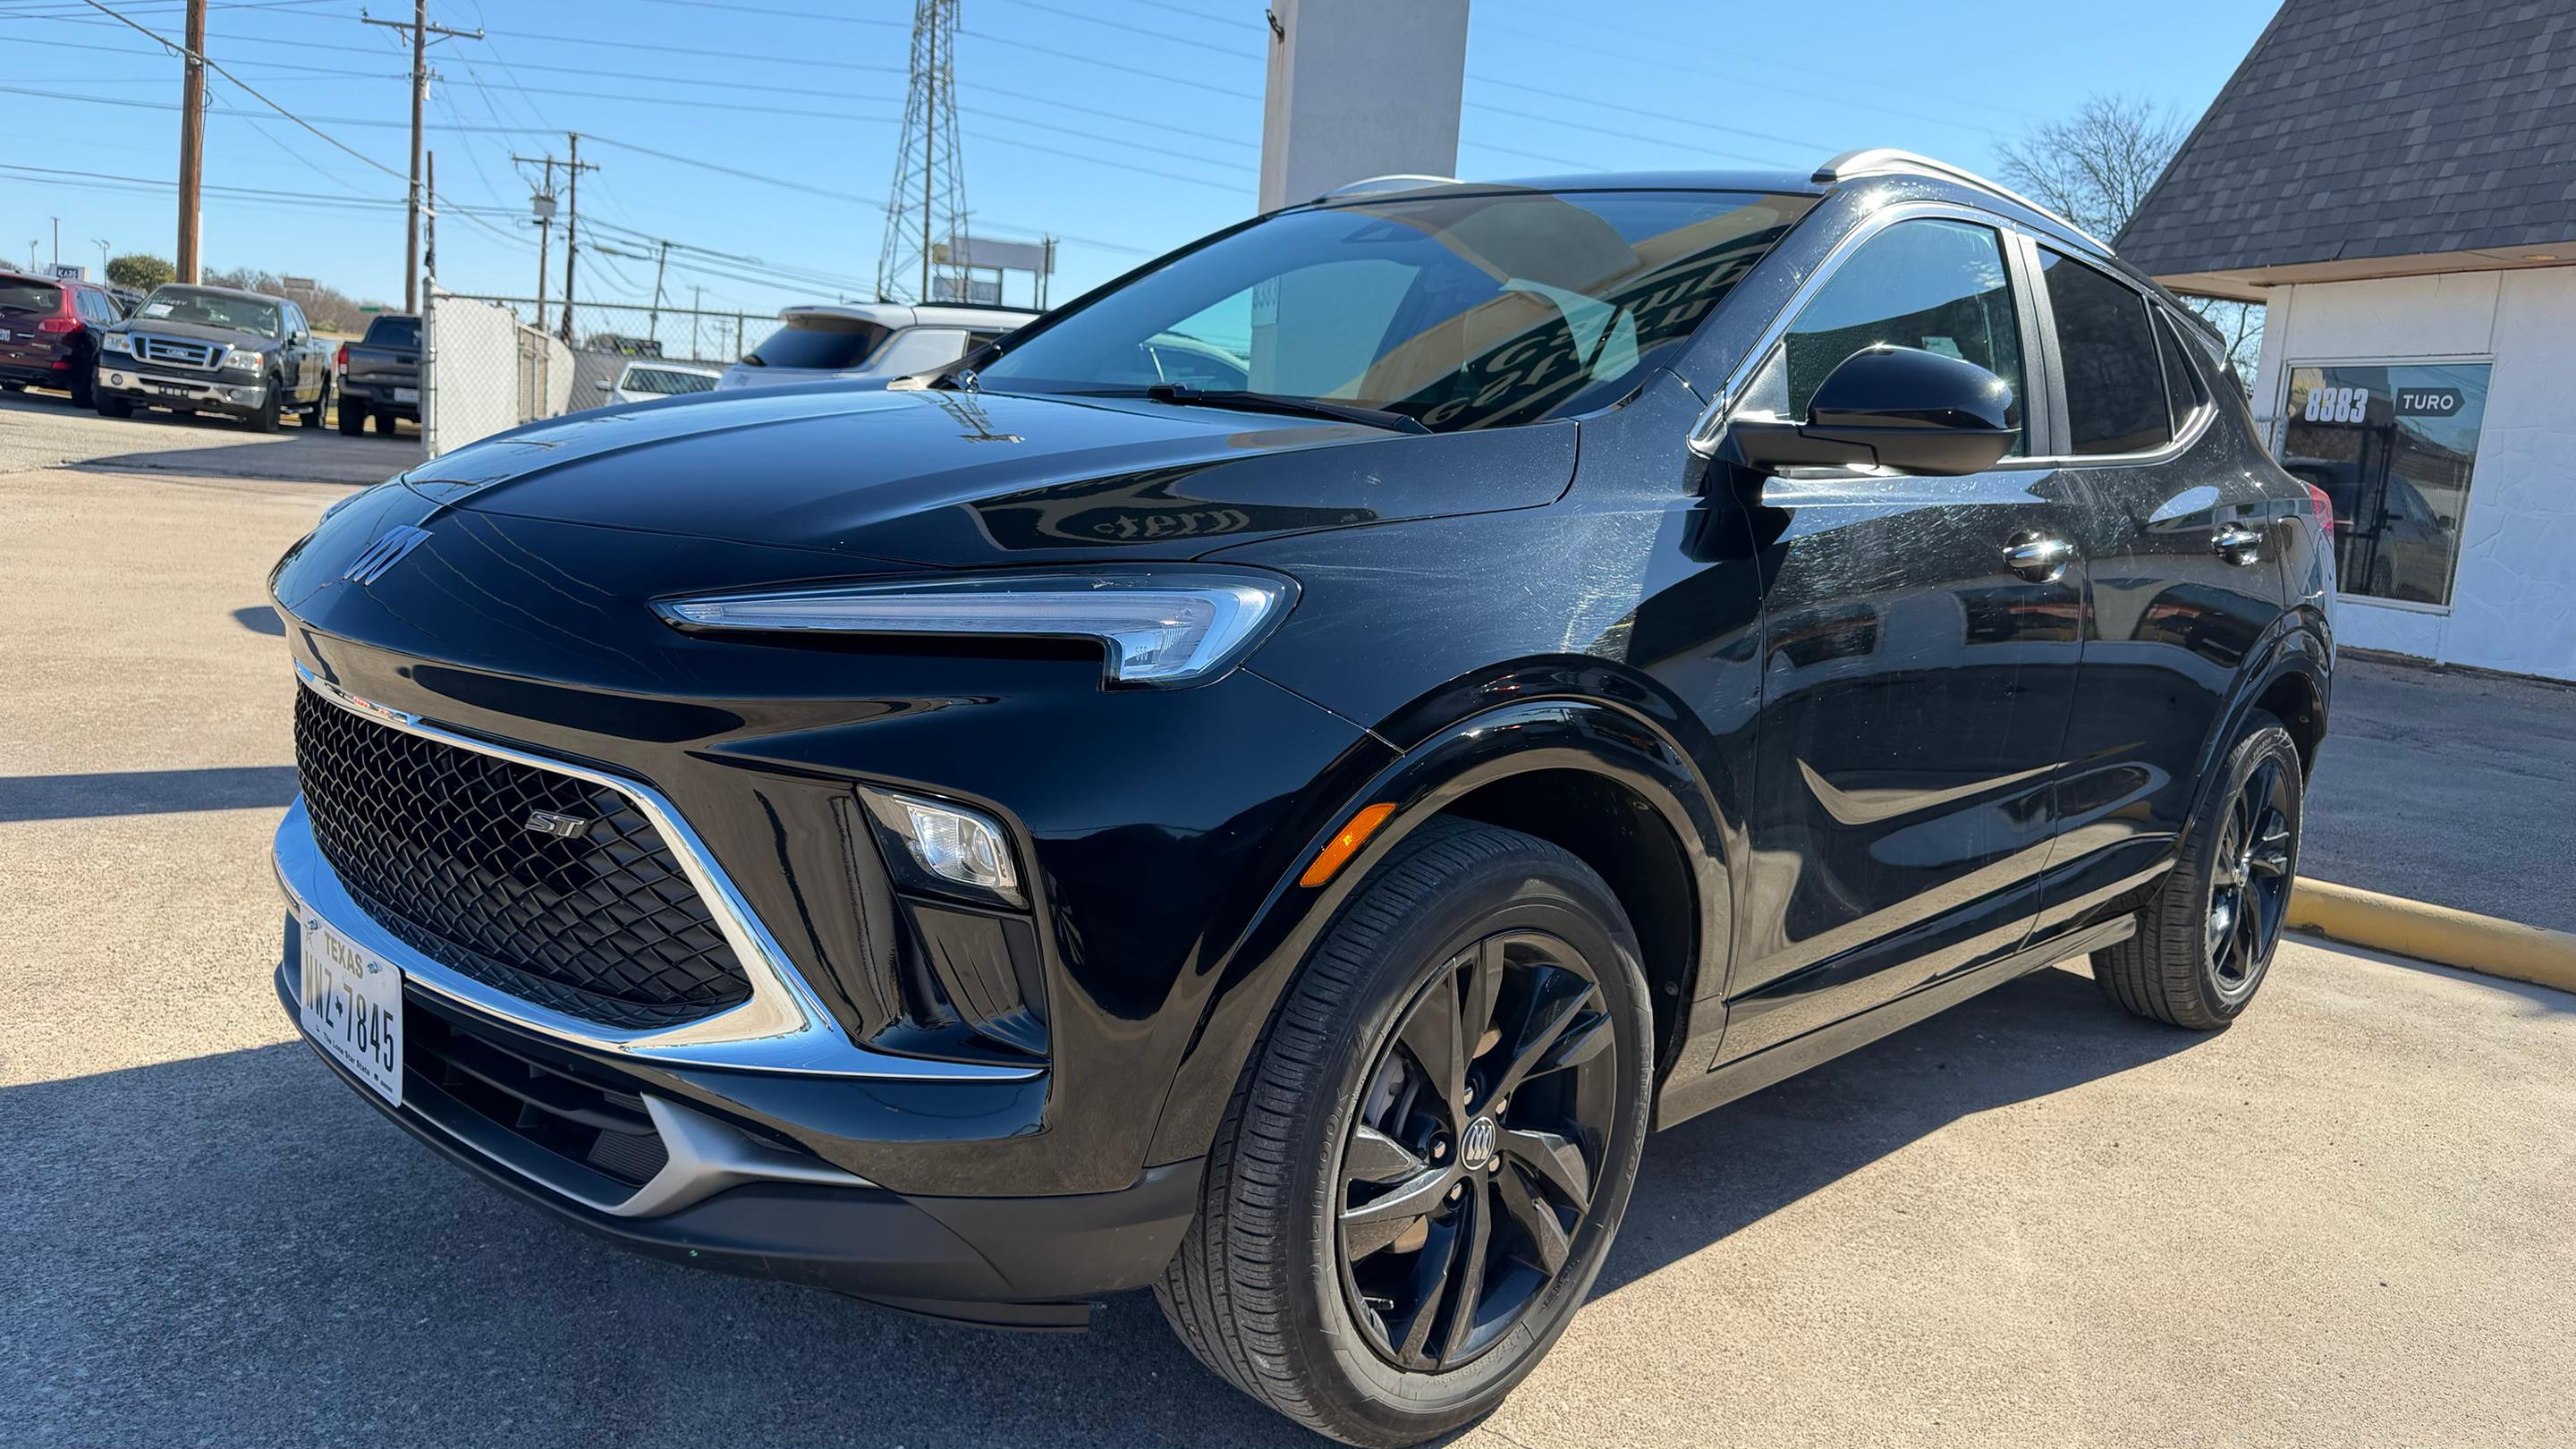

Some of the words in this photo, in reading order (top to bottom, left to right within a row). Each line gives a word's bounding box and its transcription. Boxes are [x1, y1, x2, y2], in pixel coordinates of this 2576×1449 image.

[2304, 386, 2369, 423] 8383
[2402, 394, 2454, 411] TURO
[524, 810, 586, 836] ST
[324, 931, 364, 979] TEXAS
[343, 980, 394, 1073] 7845
[333, 1039, 344, 1055] Lone
[344, 1050, 355, 1064] Star
[356, 1059, 370, 1076] State
